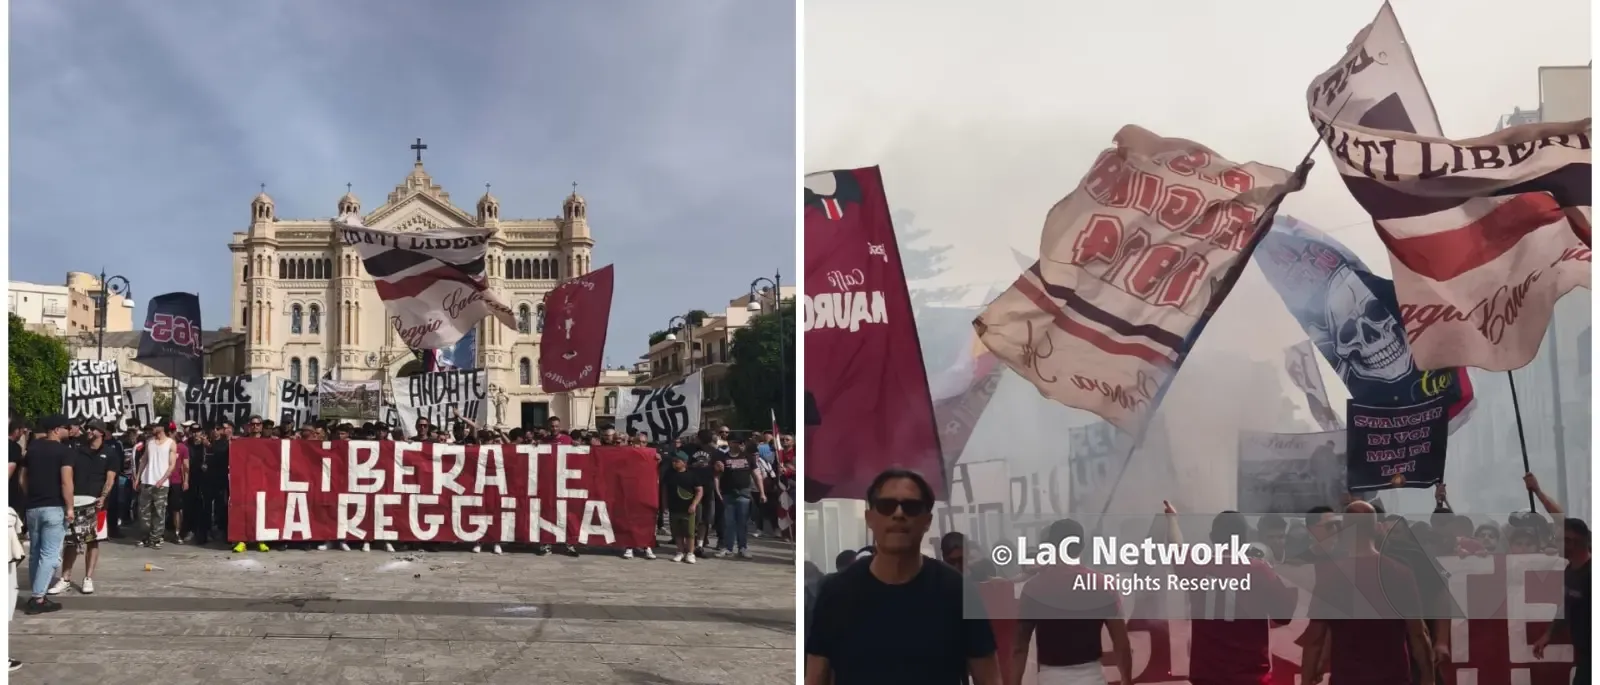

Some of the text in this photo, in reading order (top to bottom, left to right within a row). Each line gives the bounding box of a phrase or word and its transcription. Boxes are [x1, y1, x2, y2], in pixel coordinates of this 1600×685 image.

[185, 375, 252, 403] GAME
[409, 369, 486, 407] ANDATE
[631, 380, 686, 413] THE
[626, 406, 689, 444] END
[1353, 407, 1442, 429] STANCHI
[1368, 427, 1430, 445] DI VOI
[1367, 442, 1431, 462] MAI DI
[1381, 460, 1416, 477] LEI
[256, 491, 312, 541] LA
